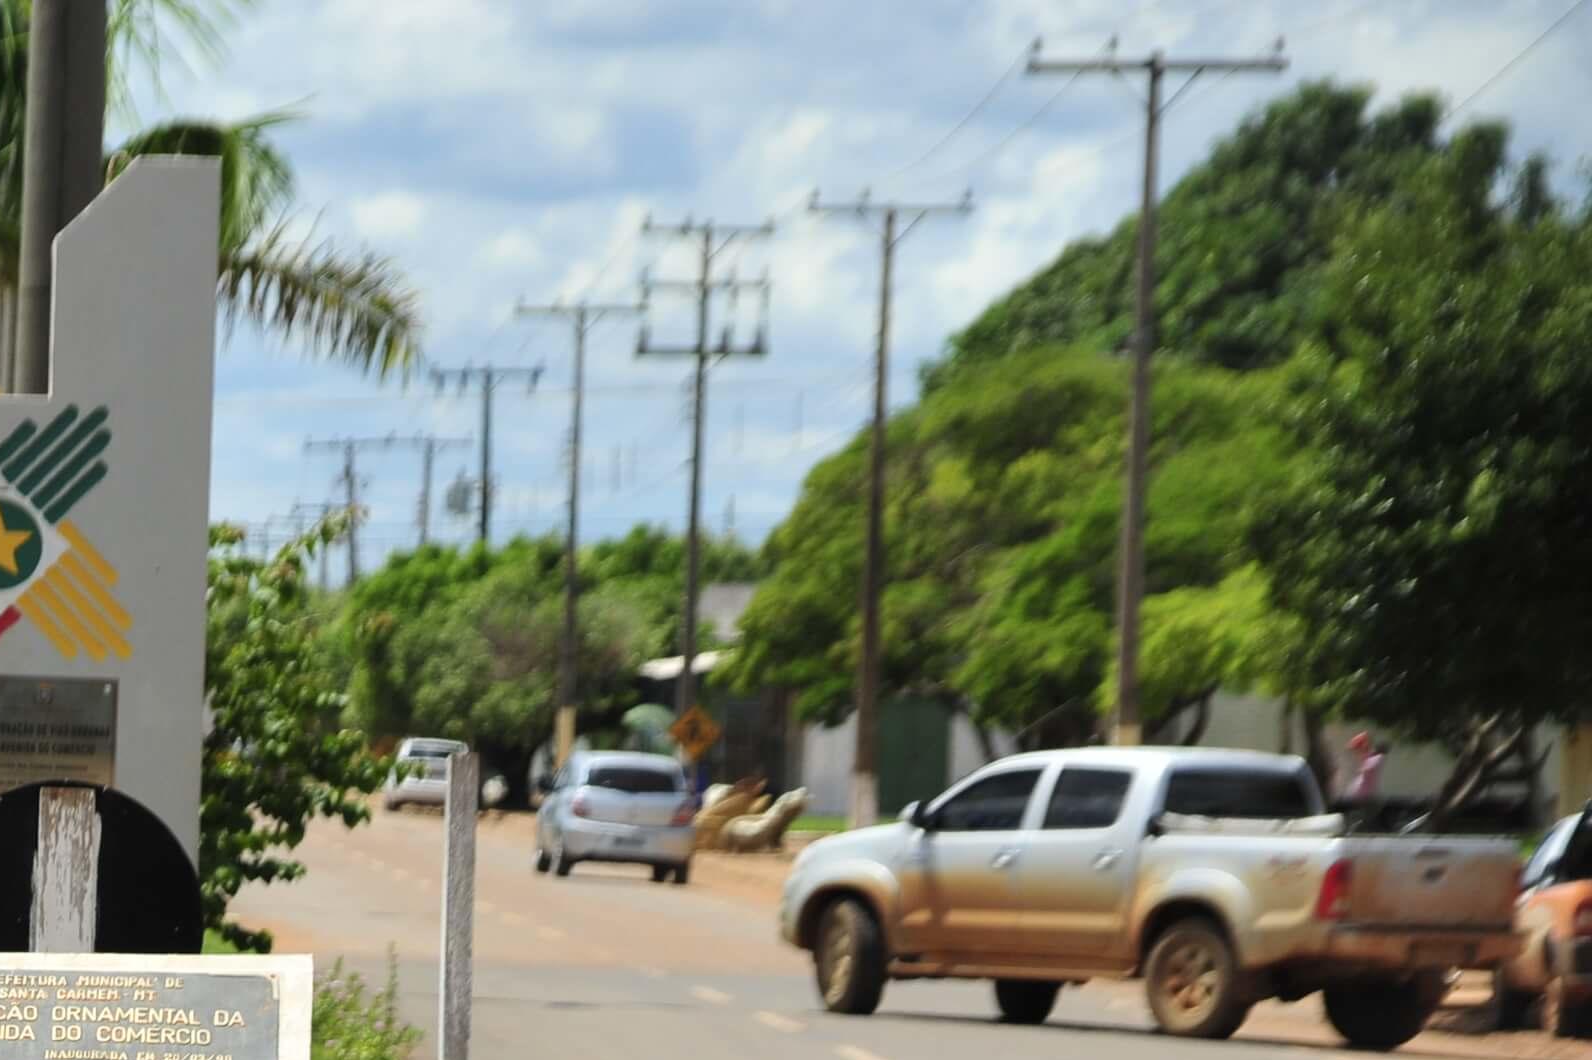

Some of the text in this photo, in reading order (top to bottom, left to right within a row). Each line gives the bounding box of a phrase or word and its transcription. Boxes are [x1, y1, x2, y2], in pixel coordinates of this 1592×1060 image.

[76, 975, 154, 988] MUNICIPAL
[164, 977, 185, 989] DE
[57, 989, 120, 1001] CARMEM
[134, 990, 156, 1001] MT
[51, 1006, 201, 1026] ORNAMENTAL
[213, 1010, 246, 1027] DA
[51, 1025, 82, 1042] DO
[96, 1025, 212, 1046] COMÉRCIO
[44, 1049, 128, 1060] INAUGURADA
